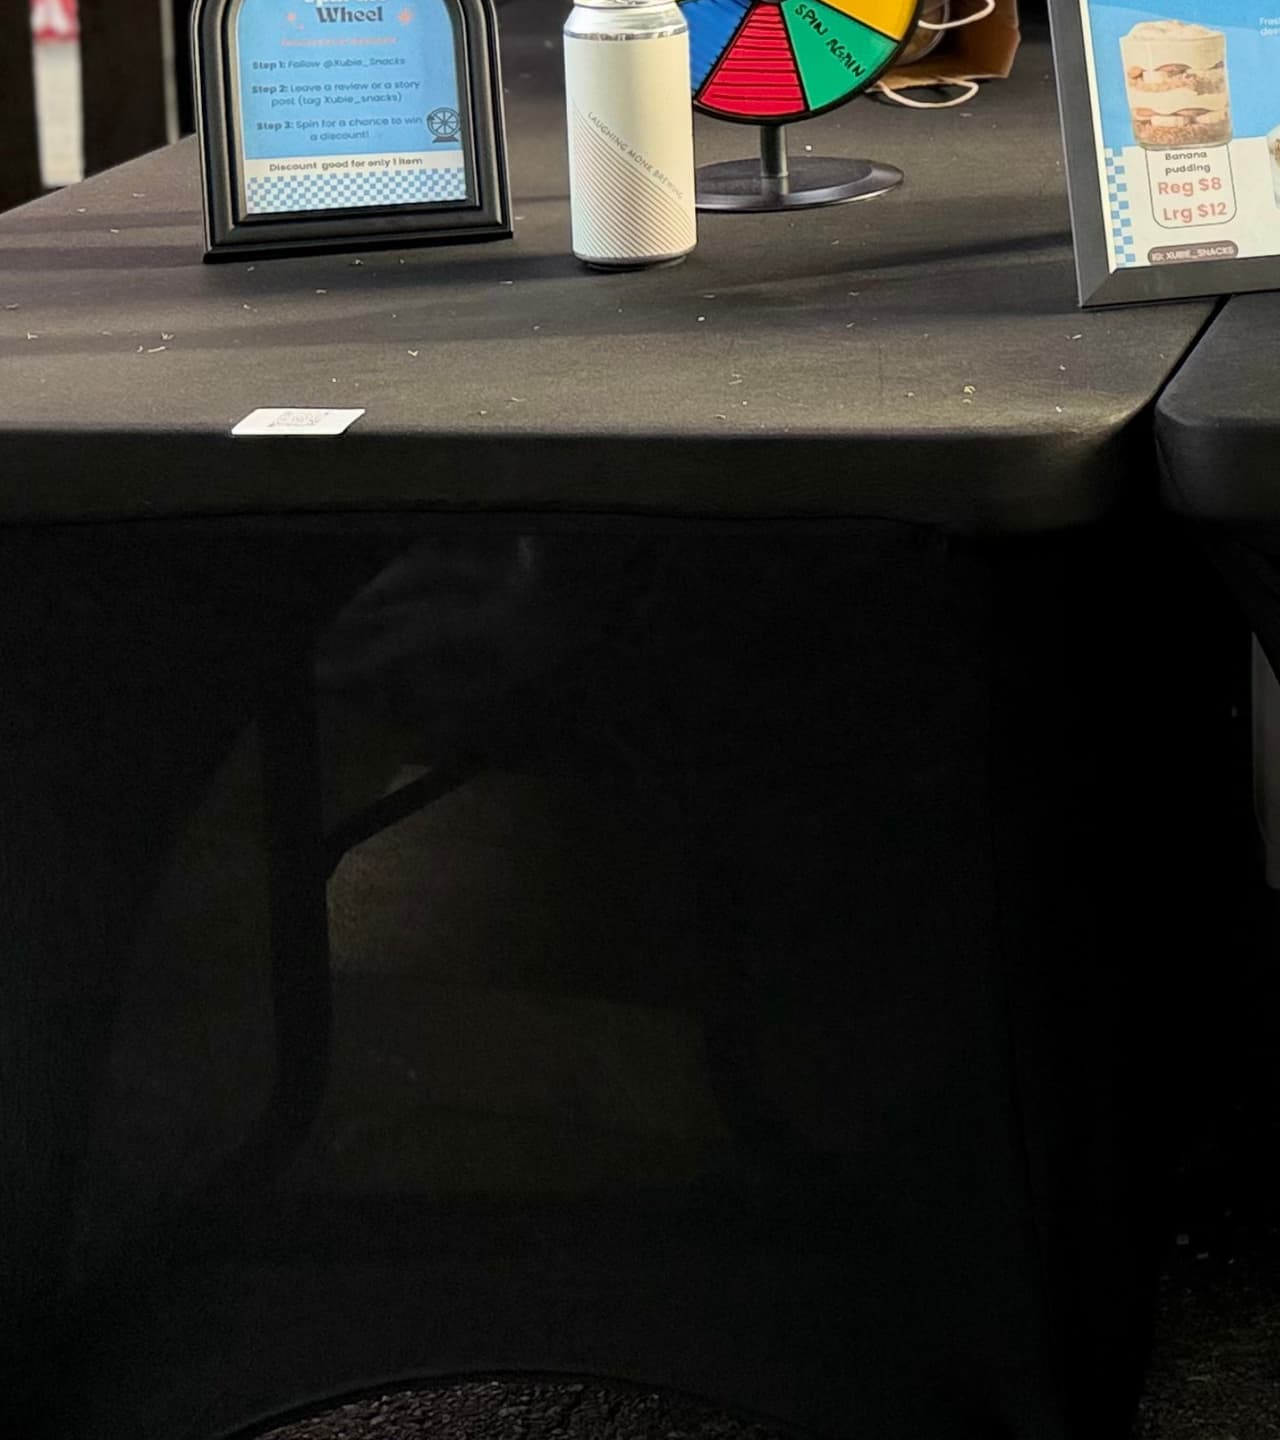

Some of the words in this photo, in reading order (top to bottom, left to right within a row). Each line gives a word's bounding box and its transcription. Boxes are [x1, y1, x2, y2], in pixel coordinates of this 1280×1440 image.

[316, 6, 384, 23] Wheel
[794, 3, 827, 36] SPIN
[252, 61, 277, 73] Step
[826, 37, 867, 79] AGAIN
[251, 85, 277, 99] Step
[334, 82, 369, 91] review
[371, 82, 382, 91] or
[384, 81, 392, 90] a
[394, 80, 420, 91] story
[404, 115, 423, 125] win
[587, 111, 629, 152] LAUGHING
[627, 149, 654, 173] MONK
[269, 161, 317, 173] Discount
[321, 160, 349, 172] good
[351, 159, 365, 169] for
[367, 158, 390, 169] only
[398, 156, 423, 166] item
[1165, 150, 1208, 161] Banana
[1165, 163, 1211, 176] pudding
[1157, 181, 1194, 197] Reg
[1198, 176, 1222, 191] $8
[1163, 207, 1193, 224] Lrg
[1197, 202, 1228, 218] $12
